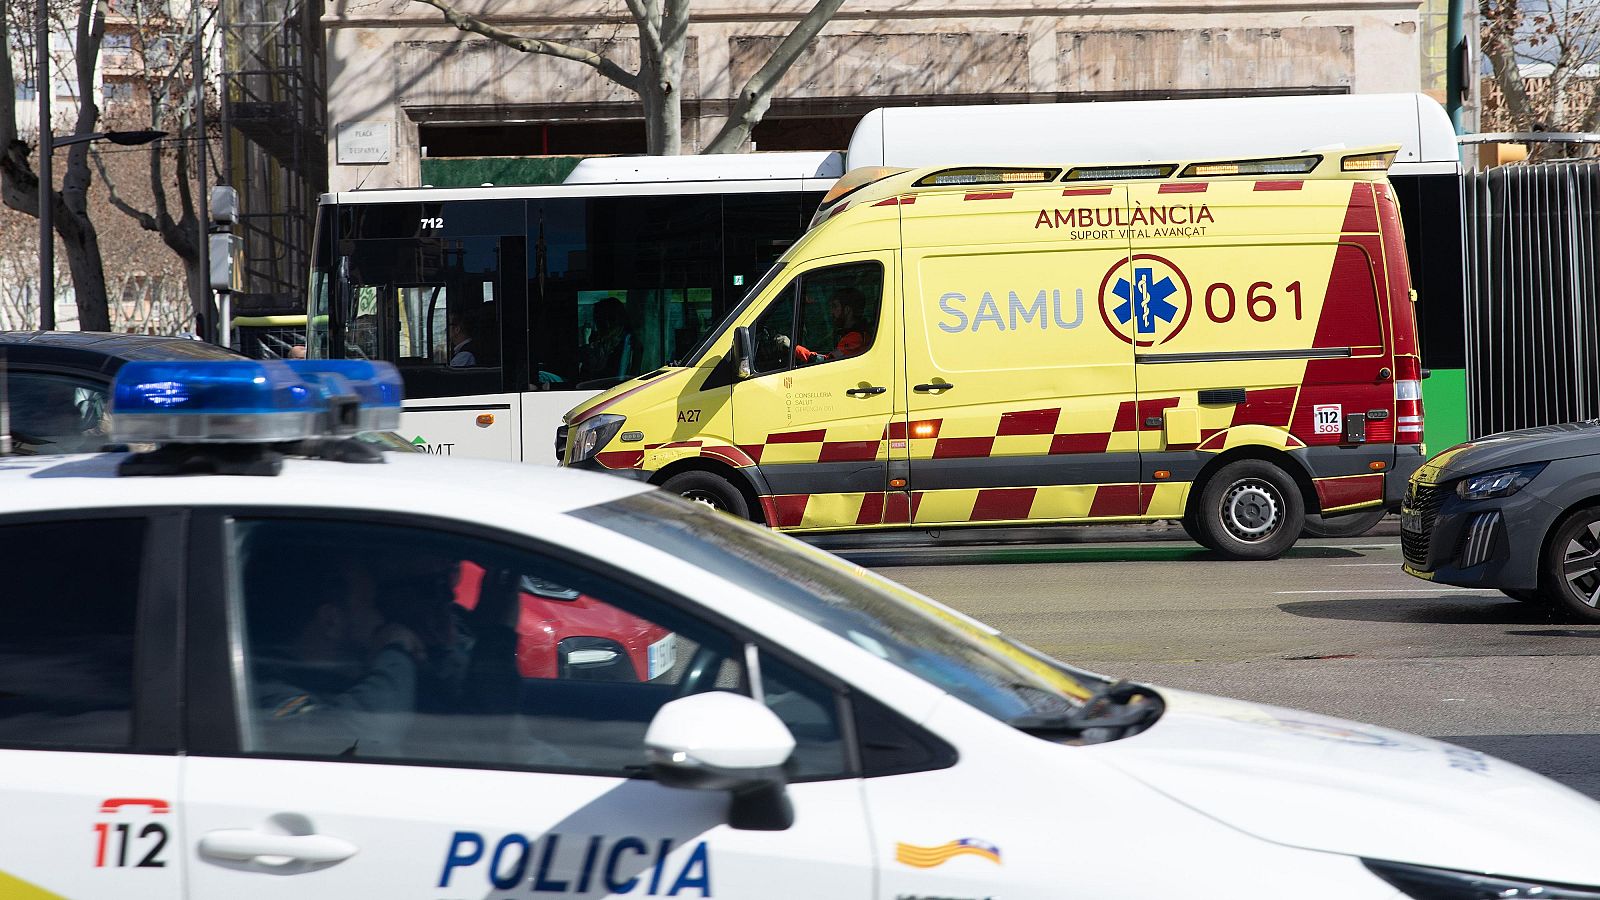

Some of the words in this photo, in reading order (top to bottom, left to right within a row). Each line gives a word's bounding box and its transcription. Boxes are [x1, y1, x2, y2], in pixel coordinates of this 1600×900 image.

[421, 217, 444, 229] 712
[1035, 200, 1215, 229] AMBULÀNCIA
[1070, 230, 1115, 241] SUPORT
[1119, 229, 1151, 240] VITAL
[1154, 227, 1207, 239] AVANÇAT
[938, 288, 1084, 333] SAMU
[1204, 281, 1302, 323] 061
[677, 409, 702, 423] A27
[1318, 411, 1338, 424] 112
[1319, 425, 1339, 433] SOS
[93, 822, 169, 868] 112
[437, 831, 712, 898] POLICIA
